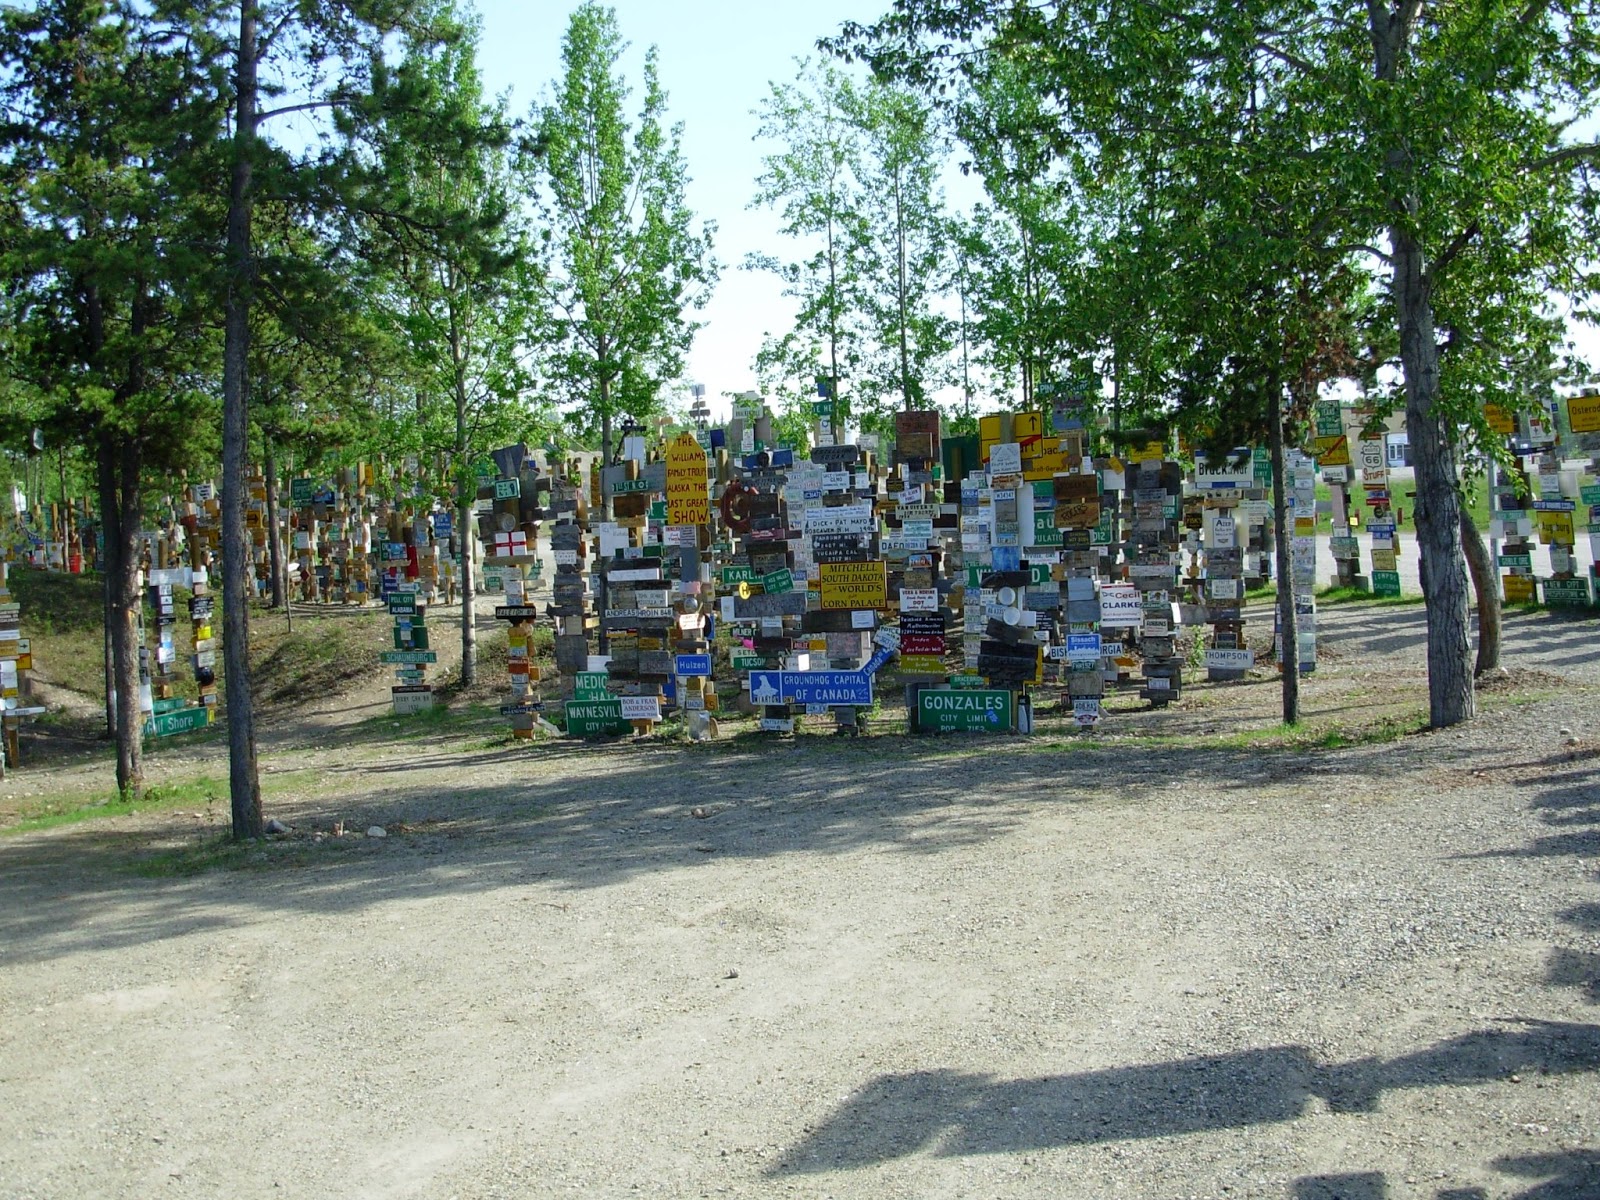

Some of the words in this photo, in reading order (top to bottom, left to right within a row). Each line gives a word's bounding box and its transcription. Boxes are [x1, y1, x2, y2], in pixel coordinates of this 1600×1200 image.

[677, 438, 692, 446] THE
[1366, 456, 1380, 464] 66
[668, 483, 690, 492] ALASKA
[694, 483, 707, 491] THE
[668, 500, 684, 508] LAST
[686, 498, 708, 507] GREAT
[674, 509, 708, 524] SHOW
[1542, 521, 1570, 534] Augburg
[830, 564, 877, 572] MITCHELL
[822, 574, 850, 583] SOUTH
[852, 574, 884, 582] DAKOTA
[838, 584, 882, 592] WORLD'S
[1115, 591, 1141, 600] Cecil
[823, 600, 848, 608] CORN
[850, 599, 884, 607] PALACE
[1204, 651, 1248, 660] THOMPSON
[784, 676, 830, 684] GROUNDHOG
[834, 675, 866, 685] CAPITAL
[796, 689, 808, 700] OF
[816, 689, 857, 700] CANADA
[924, 696, 1004, 710] GONZALES
[568, 706, 622, 718] WAYNESVILL
[940, 714, 958, 722] CITY
[966, 714, 988, 722] LIMIT
[168, 716, 194, 730] Shore
[586, 722, 600, 731] CITY
